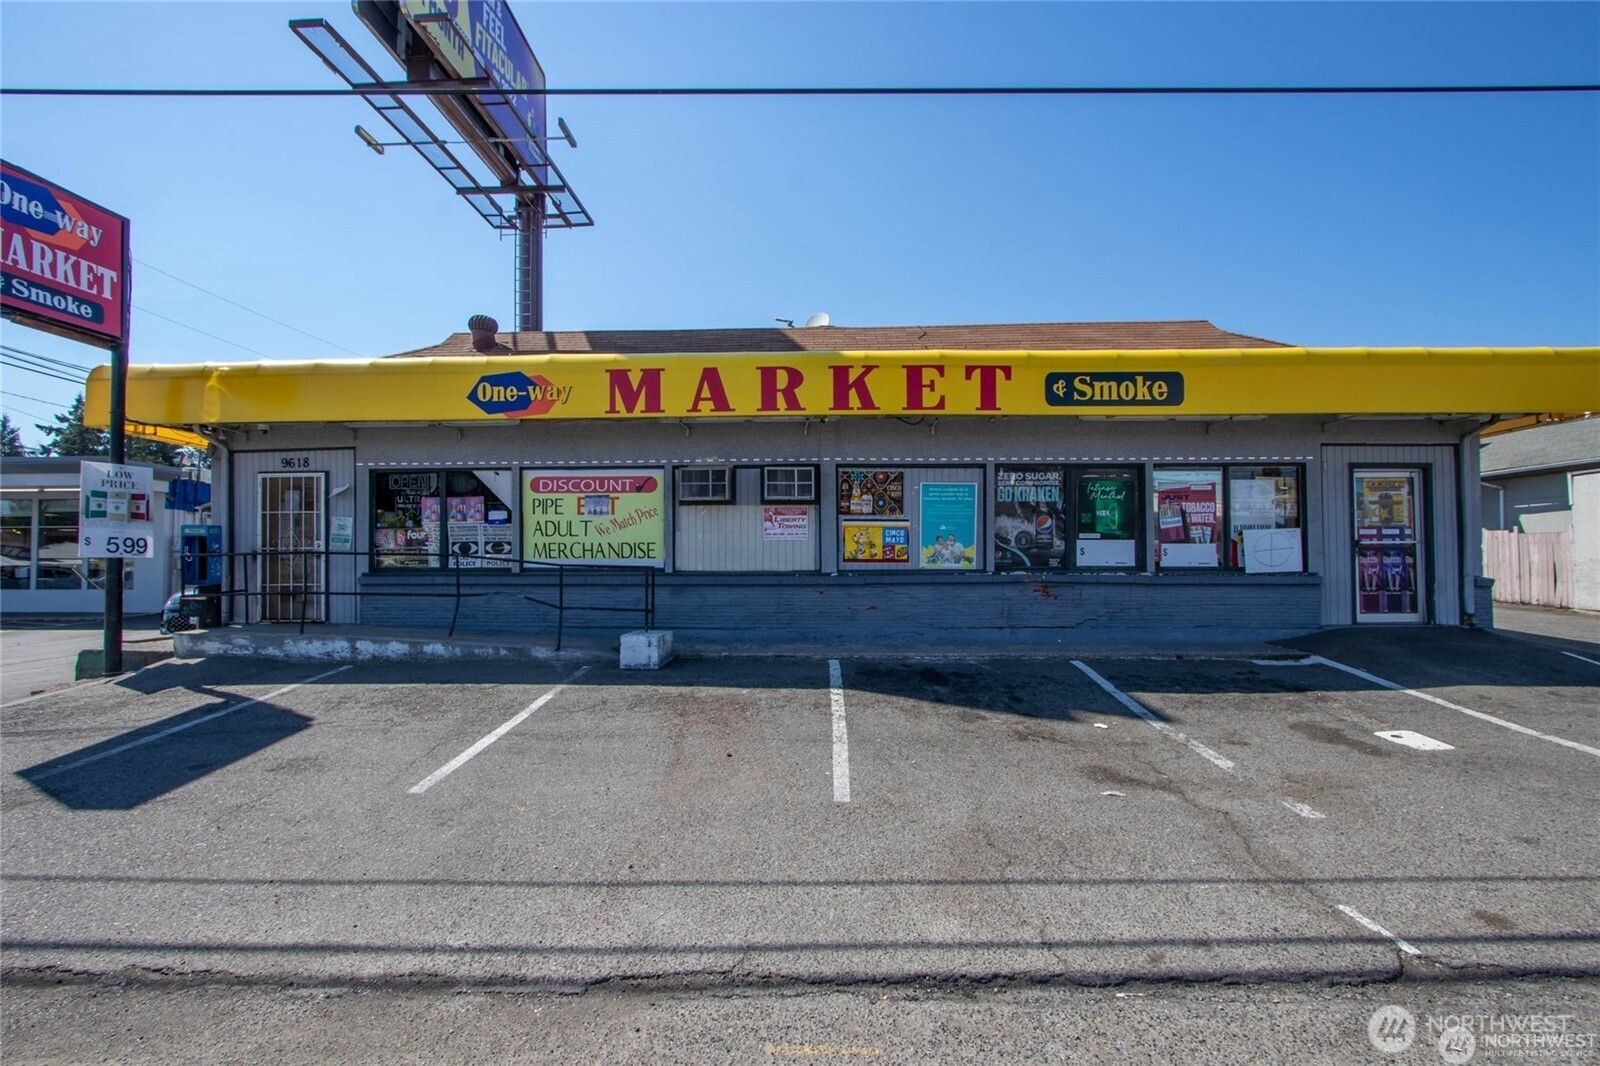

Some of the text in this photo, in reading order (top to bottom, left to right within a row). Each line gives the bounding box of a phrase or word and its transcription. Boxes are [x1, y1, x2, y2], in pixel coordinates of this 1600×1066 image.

[483, 1, 506, 52] FEEL
[0, 226, 118, 300] ARKET
[11, 278, 93, 318] Smoke
[476, 365, 1169, 415] One-way MARKET & Smoke
[281, 457, 310, 469] 9618
[107, 470, 135, 480] LOW
[391, 475, 428, 488] OPEN
[997, 471, 1062, 480] ZERO SUGAR.
[101, 479, 138, 490] PRICE
[539, 479, 634, 492] DISCOUNT
[997, 486, 1060, 502] GO KRAKEN
[532, 497, 564, 515] PIPE
[1181, 502, 1216, 512] TOBACCO
[610, 510, 637, 534] Match
[636, 505, 659, 524] Price
[1190, 513, 1216, 523] WATER.
[533, 520, 593, 537] ADULT
[777, 522, 807, 530] TOWING
[885, 529, 905, 537] CINCO
[84, 536, 148, 556] $ 5.99
[533, 541, 657, 559] MERCHANDISE
